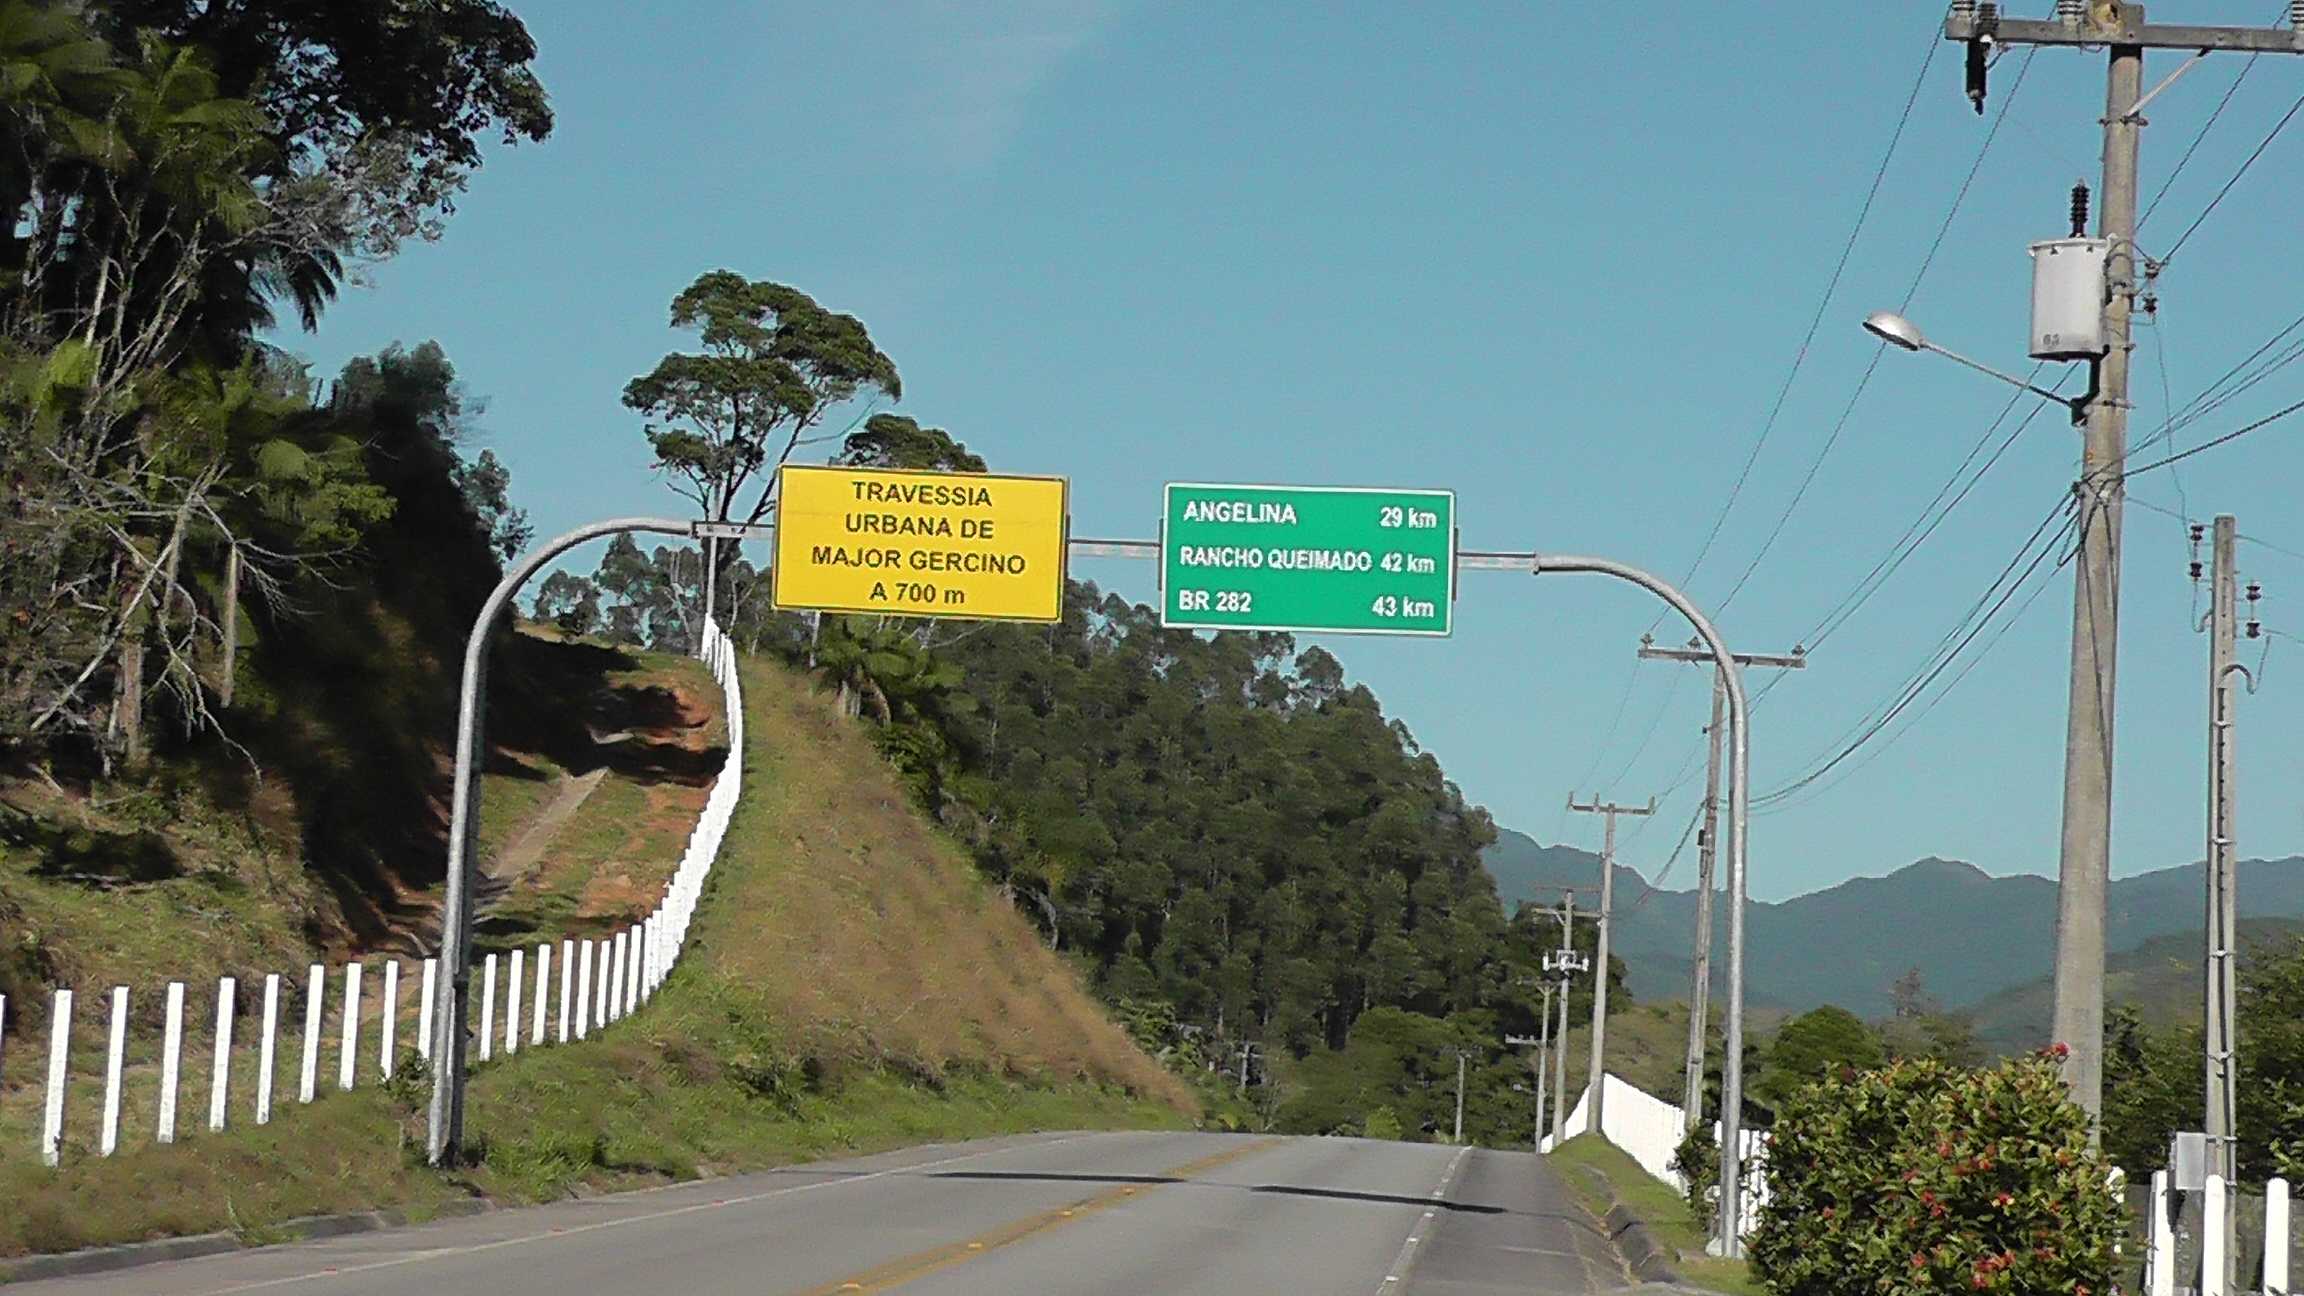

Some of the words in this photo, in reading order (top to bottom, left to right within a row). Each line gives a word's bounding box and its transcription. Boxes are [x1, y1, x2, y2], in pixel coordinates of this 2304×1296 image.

[852, 481, 993, 507] TRAVESSIA
[845, 513, 953, 537] URBANA
[960, 519, 993, 539] DE
[1183, 500, 1298, 526] ANGELINA
[1379, 506, 1403, 528] 29
[1408, 507, 1437, 529] km
[812, 545, 902, 569] MAJOR
[909, 550, 1025, 575] GERCINO
[1180, 545, 1264, 569] RANCHO
[1267, 548, 1373, 573] QUEIMADO
[1380, 552, 1403, 573] 42
[1406, 553, 1435, 574] km
[869, 581, 888, 601] A
[895, 582, 936, 603] 700
[944, 589, 965, 604] m
[1179, 589, 1210, 611] BR
[1215, 591, 1252, 613] 282
[1372, 595, 1399, 617] 43
[1402, 596, 1435, 618] km
